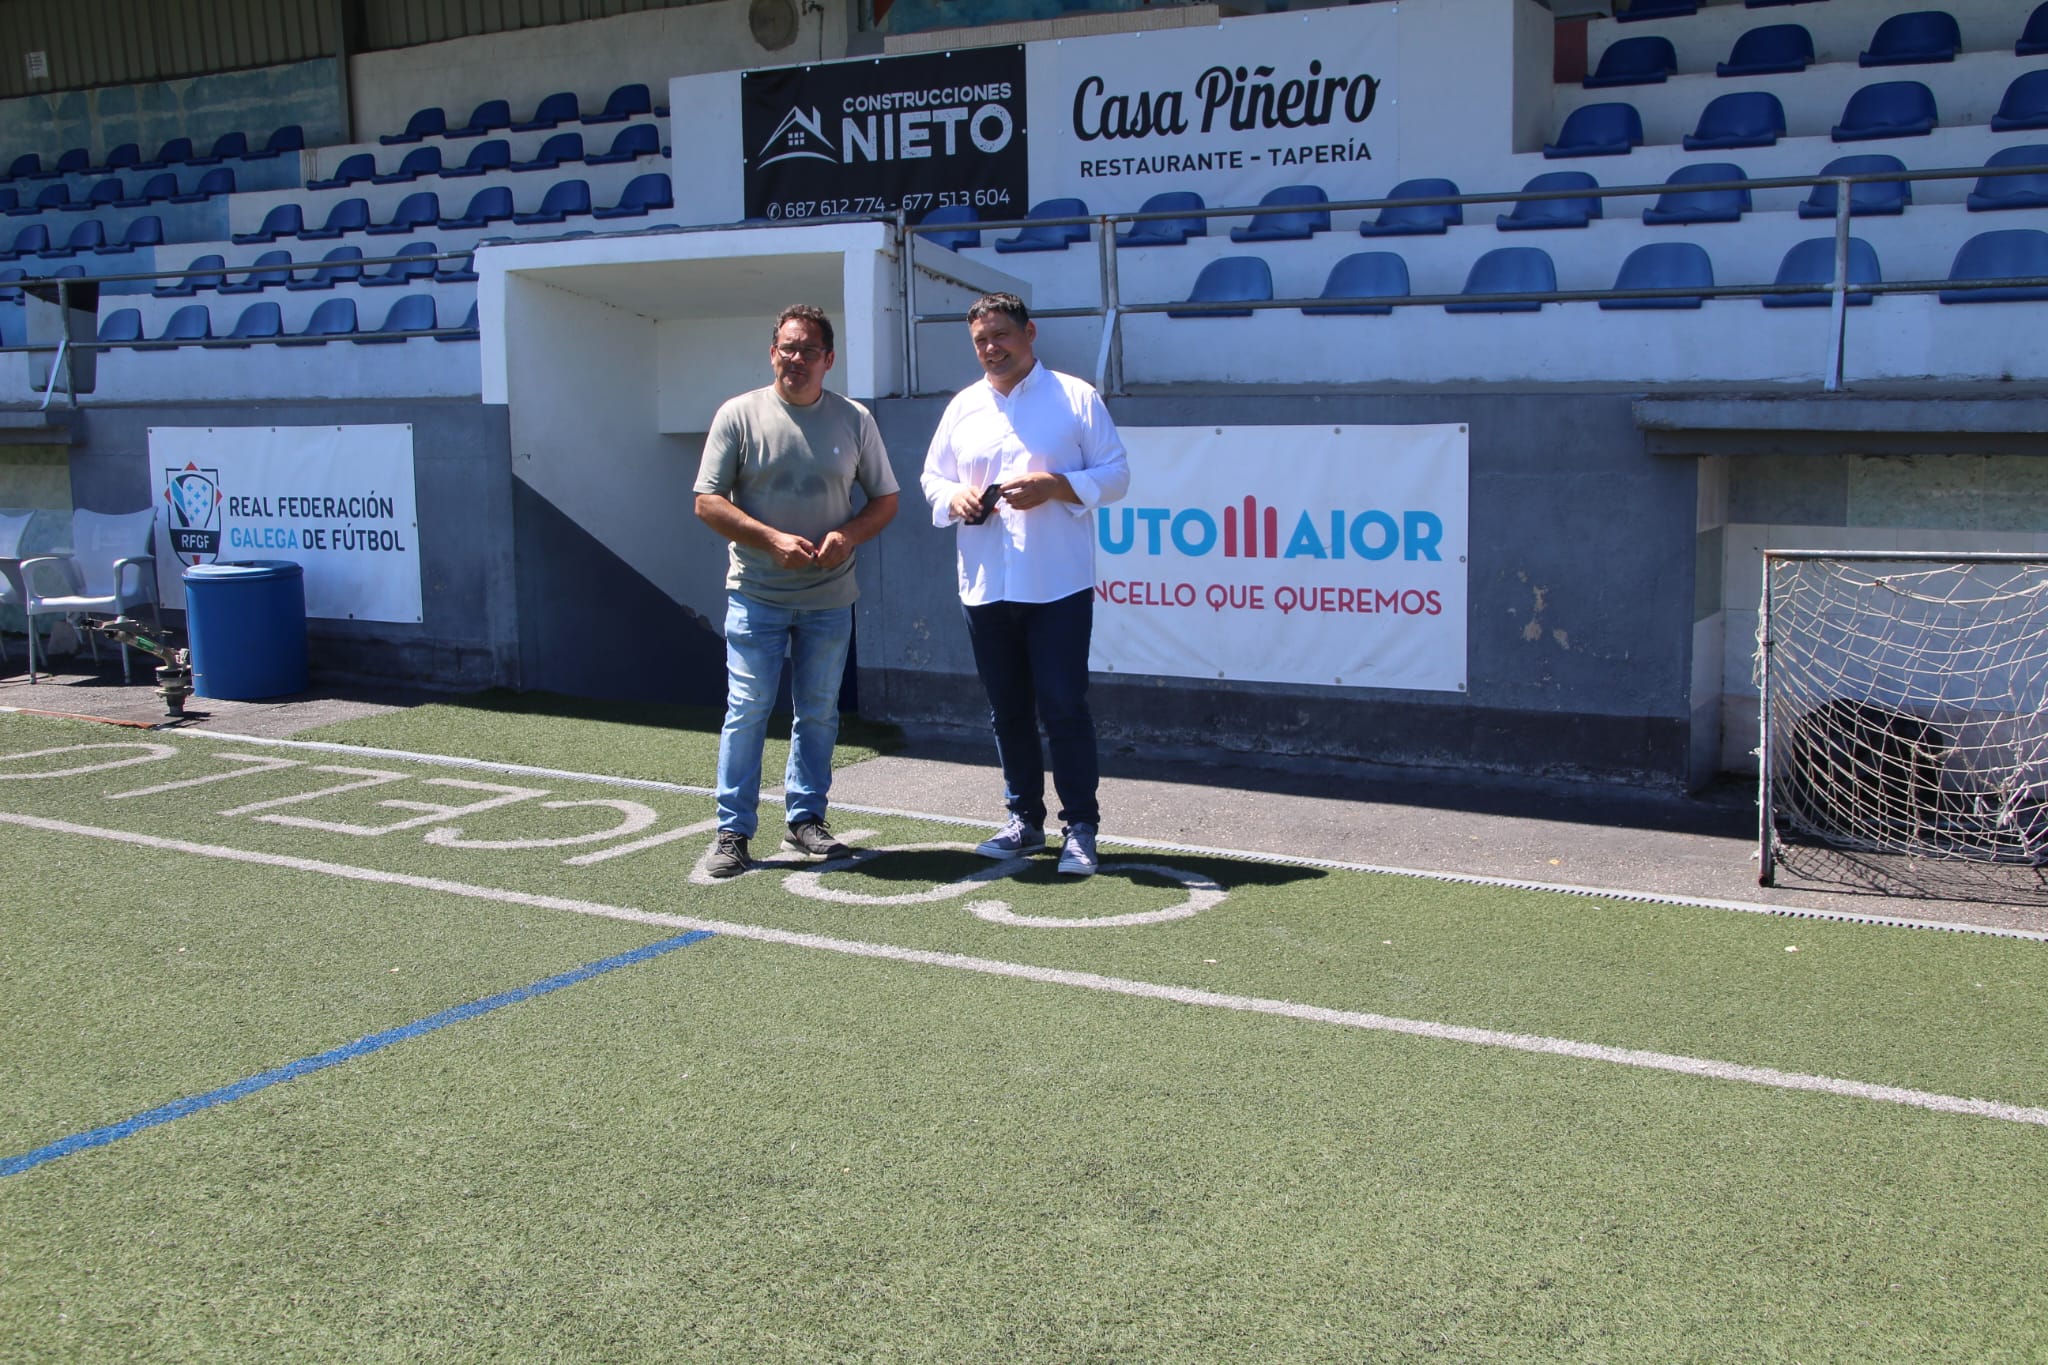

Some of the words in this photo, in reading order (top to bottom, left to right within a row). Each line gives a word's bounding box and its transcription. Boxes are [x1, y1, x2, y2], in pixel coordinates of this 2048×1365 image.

[842, 82, 1012, 113] CONSTRUCCIONES
[1073, 76, 1188, 142] Casa
[1194, 59, 1381, 134] Piñeiro
[843, 103, 1013, 164] NIETO
[1080, 150, 1243, 178] RESTAURANTE
[1268, 137, 1372, 167] TAPERÍA
[785, 202, 815, 218] 687
[820, 199, 849, 216] 612
[854, 197, 885, 212] 774
[902, 193, 933, 210] 677
[939, 191, 969, 207] 513
[975, 188, 1010, 206] 604
[229, 497, 273, 517] REAL
[279, 490, 394, 518] FEDERACIÓN
[181, 533, 209, 550] RFGF
[231, 527, 298, 549] GALEGA
[303, 528, 327, 550] DE
[333, 523, 405, 551] FÚTBOL
[1206, 583, 1265, 612] QUE
[1274, 585, 1443, 615] QUEREMOS
